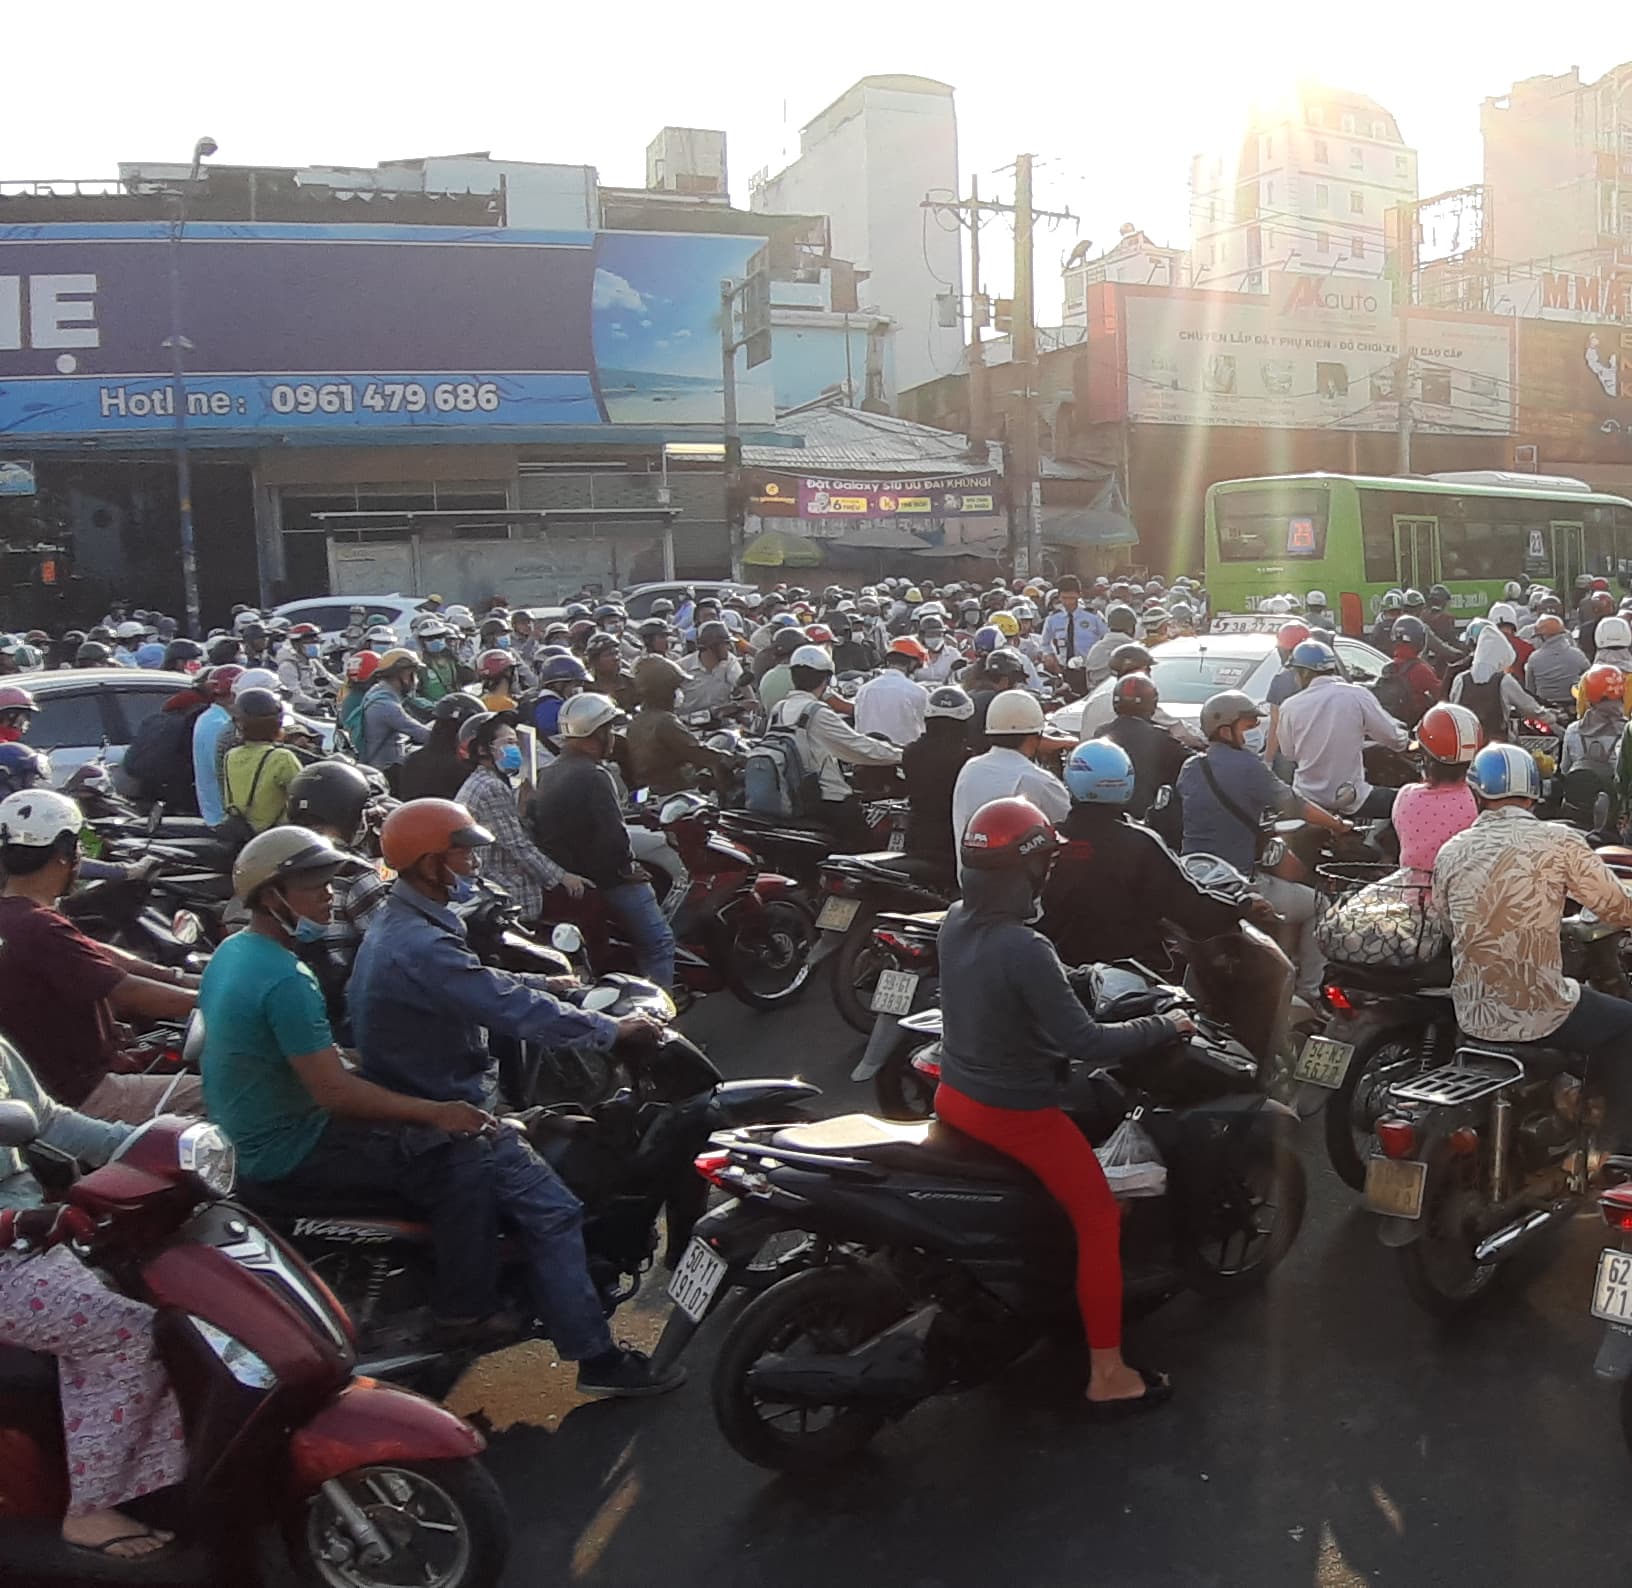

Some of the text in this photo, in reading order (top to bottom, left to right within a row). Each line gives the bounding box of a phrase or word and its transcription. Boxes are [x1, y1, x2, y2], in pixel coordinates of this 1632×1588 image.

[100, 383, 499, 417] Hotlne: 0961 479 686
[833, 481, 880, 493] Galaxy
[1019, 834, 1047, 855] SAPA
[670, 1270, 709, 1315] 191.07
